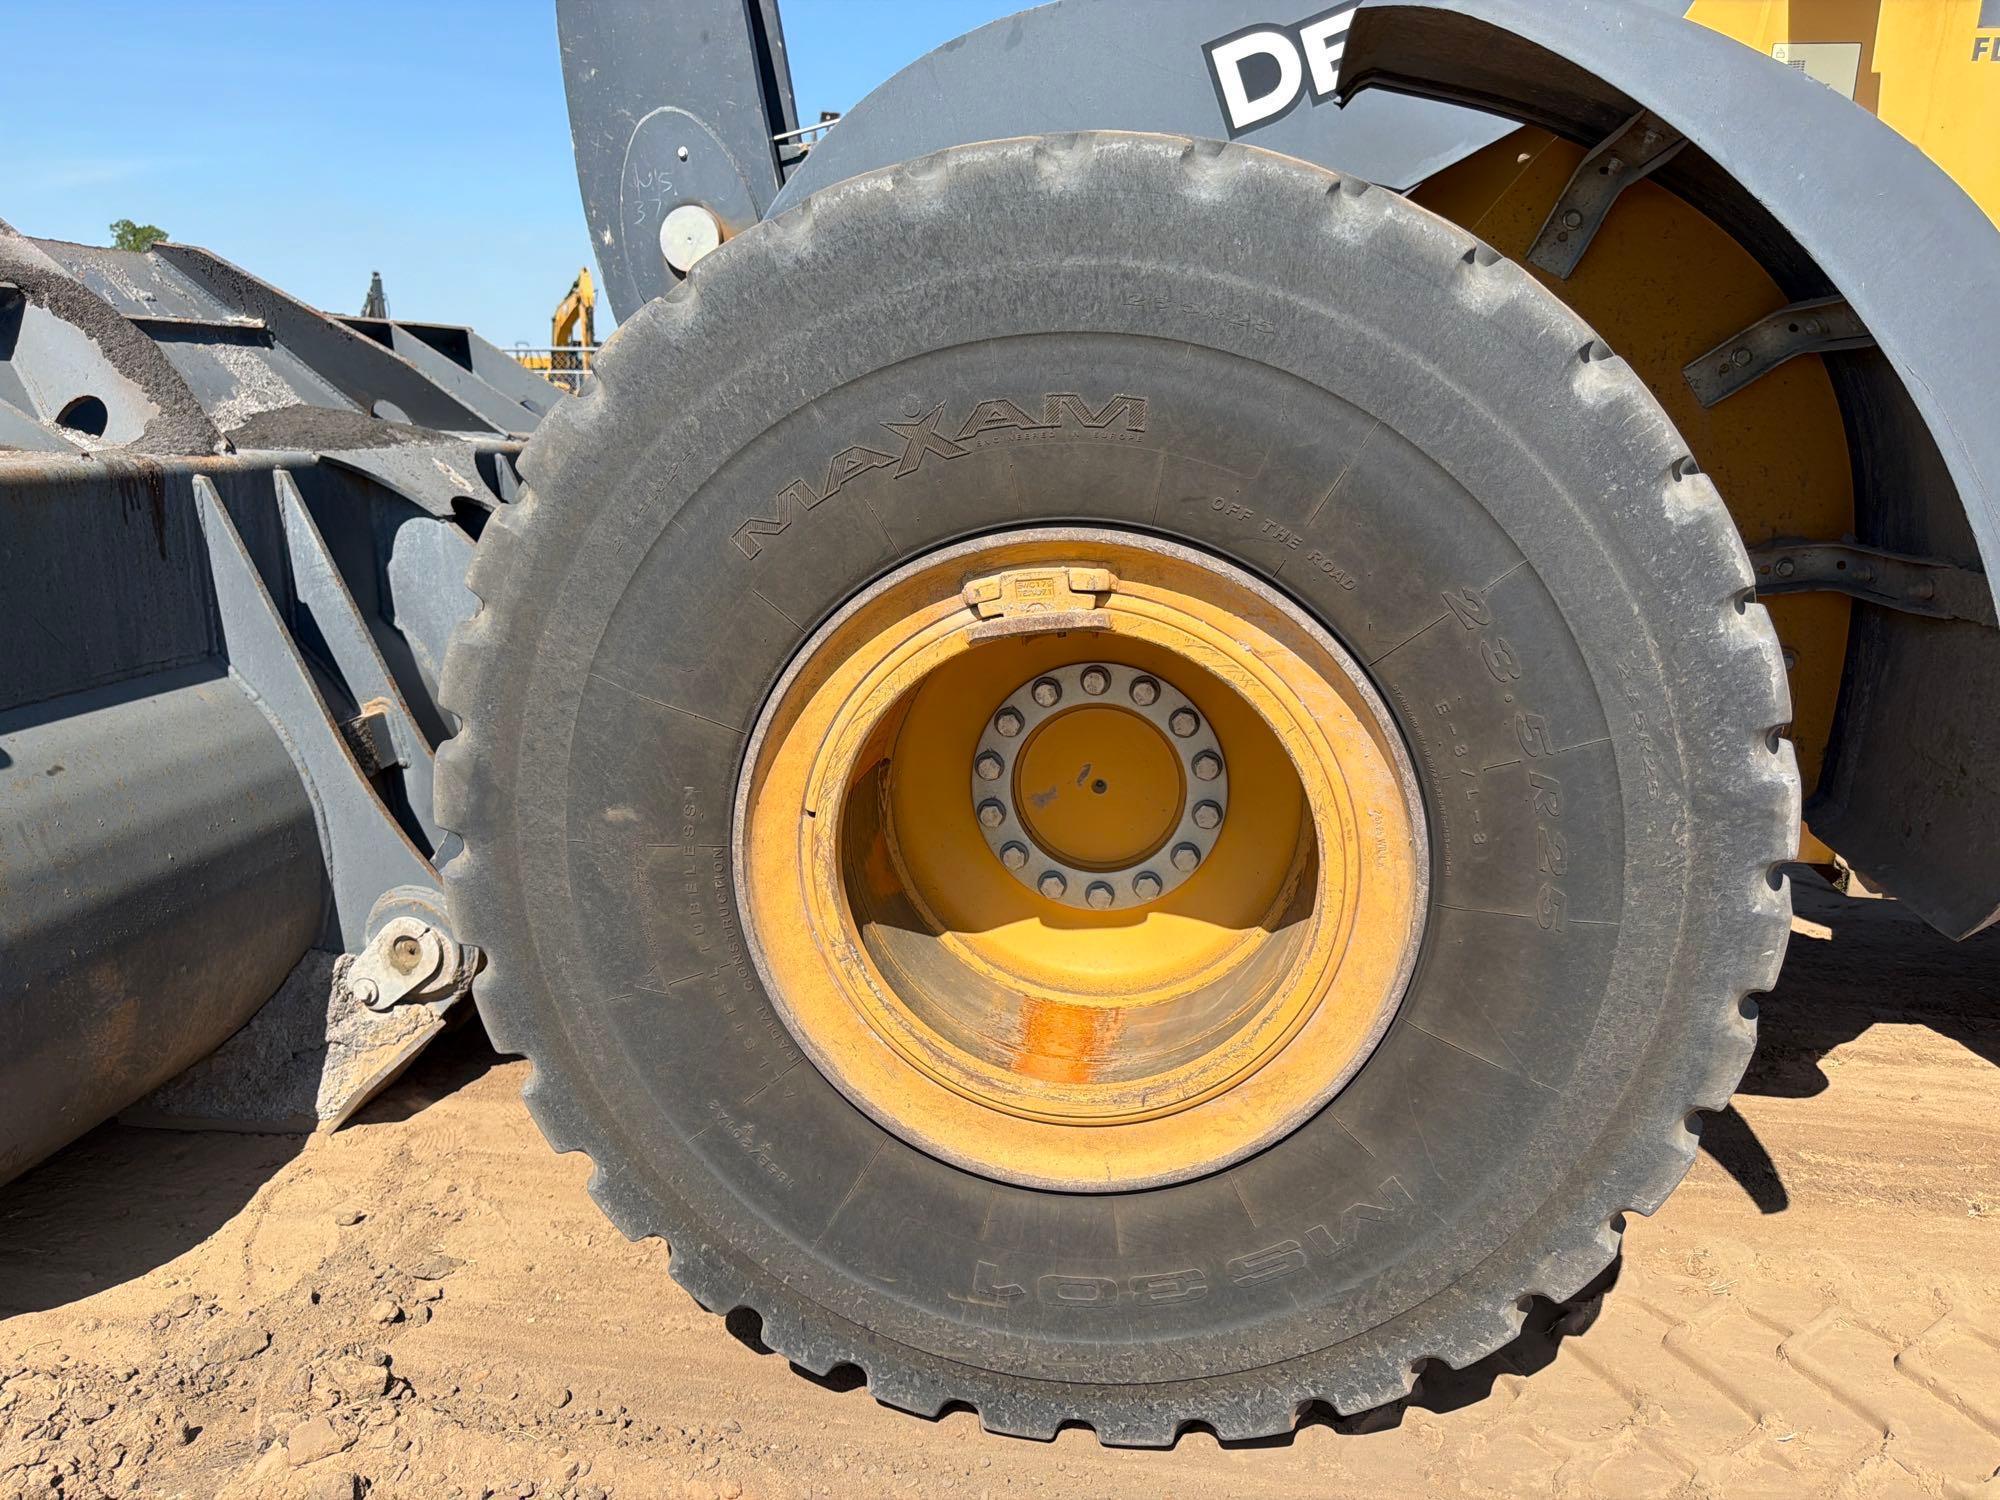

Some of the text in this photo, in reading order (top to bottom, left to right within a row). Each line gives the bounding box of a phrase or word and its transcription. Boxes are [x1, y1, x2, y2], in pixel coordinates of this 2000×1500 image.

[730, 391, 1148, 560] MAXAM
[976, 430, 1056, 448] ENGNEERED
[1211, 496, 1358, 591] OFF THE ROAD
[1435, 700, 1488, 845] E-3/L-3
[1441, 586, 1568, 934] 23.5R25
[683, 803, 711, 953] TUBELESS
[713, 847, 801, 1063] RADIAL CONSTRUCTION
